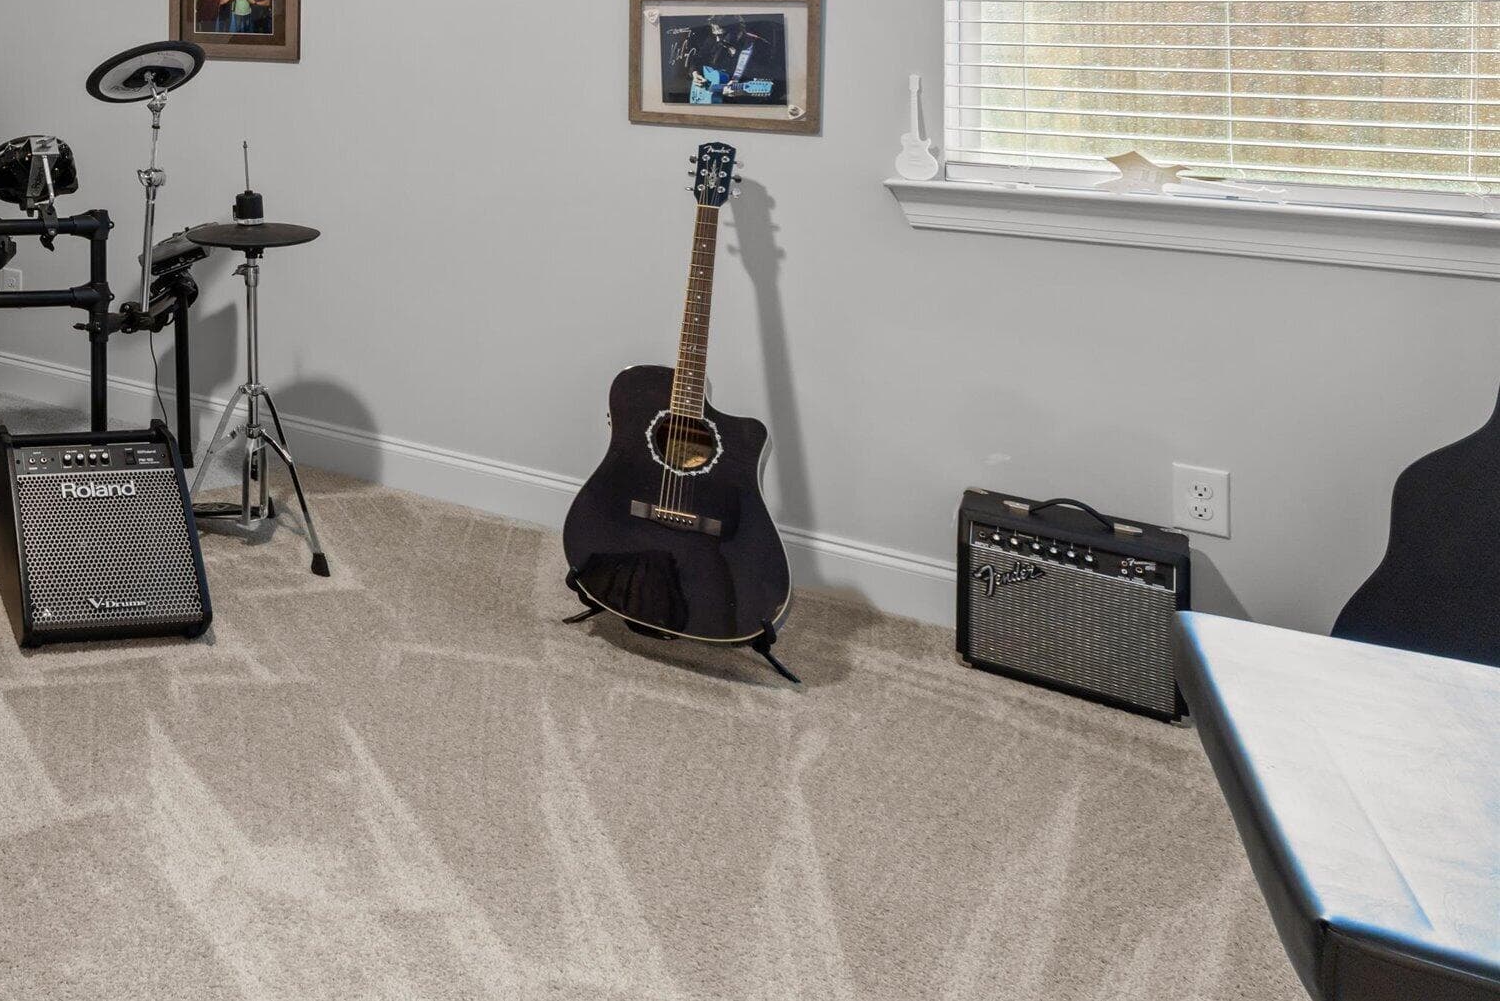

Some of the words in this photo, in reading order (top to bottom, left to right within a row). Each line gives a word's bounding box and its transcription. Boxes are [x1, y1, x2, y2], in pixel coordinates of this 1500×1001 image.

[61, 480, 137, 499] Roland
[974, 560, 1043, 597] Fender
[88, 597, 147, 609] V-Drums
